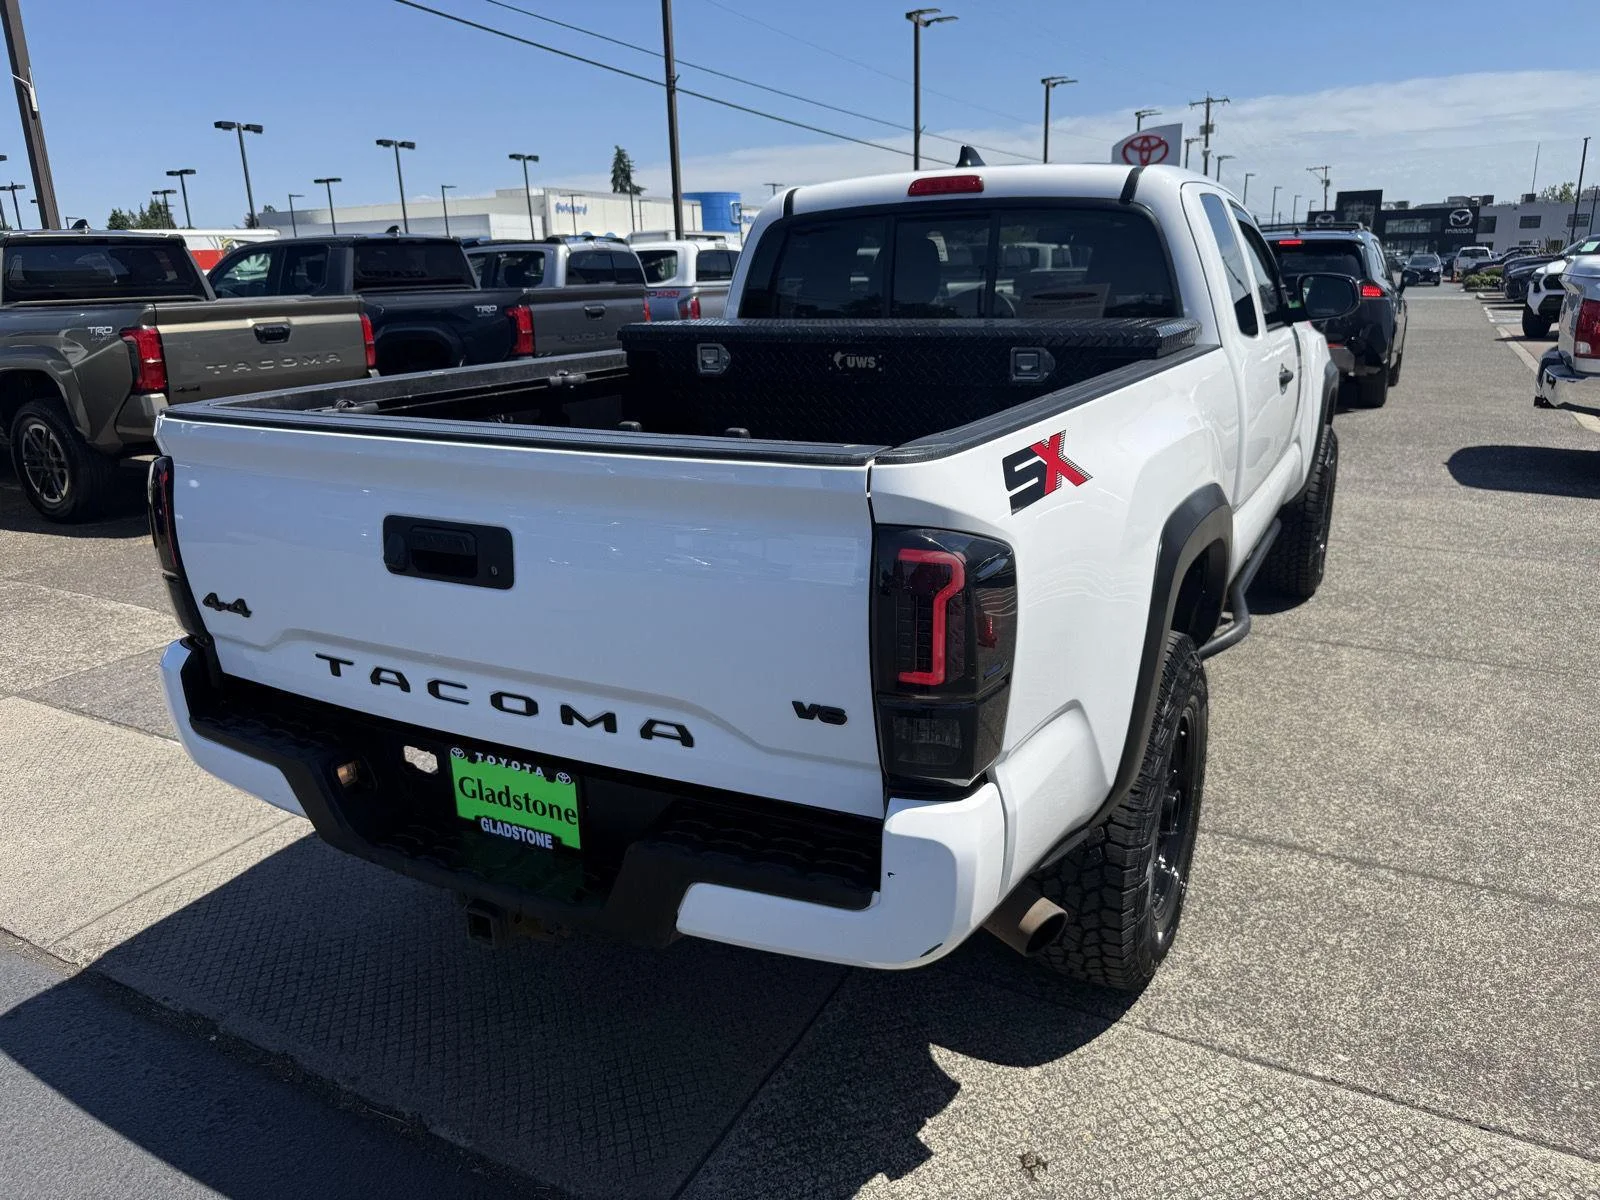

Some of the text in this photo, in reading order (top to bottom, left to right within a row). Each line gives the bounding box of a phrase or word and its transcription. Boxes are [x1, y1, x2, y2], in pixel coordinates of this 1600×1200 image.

[87, 326, 113, 336] TRD
[205, 353, 341, 375] TACOMA
[846, 356, 876, 369] UWS
[315, 652, 694, 748] TACOMA
[791, 700, 848, 726] V6
[475, 751, 545, 778] TOYOTA
[458, 776, 578, 825] Gladstone
[480, 817, 554, 850] GLADSTONE
